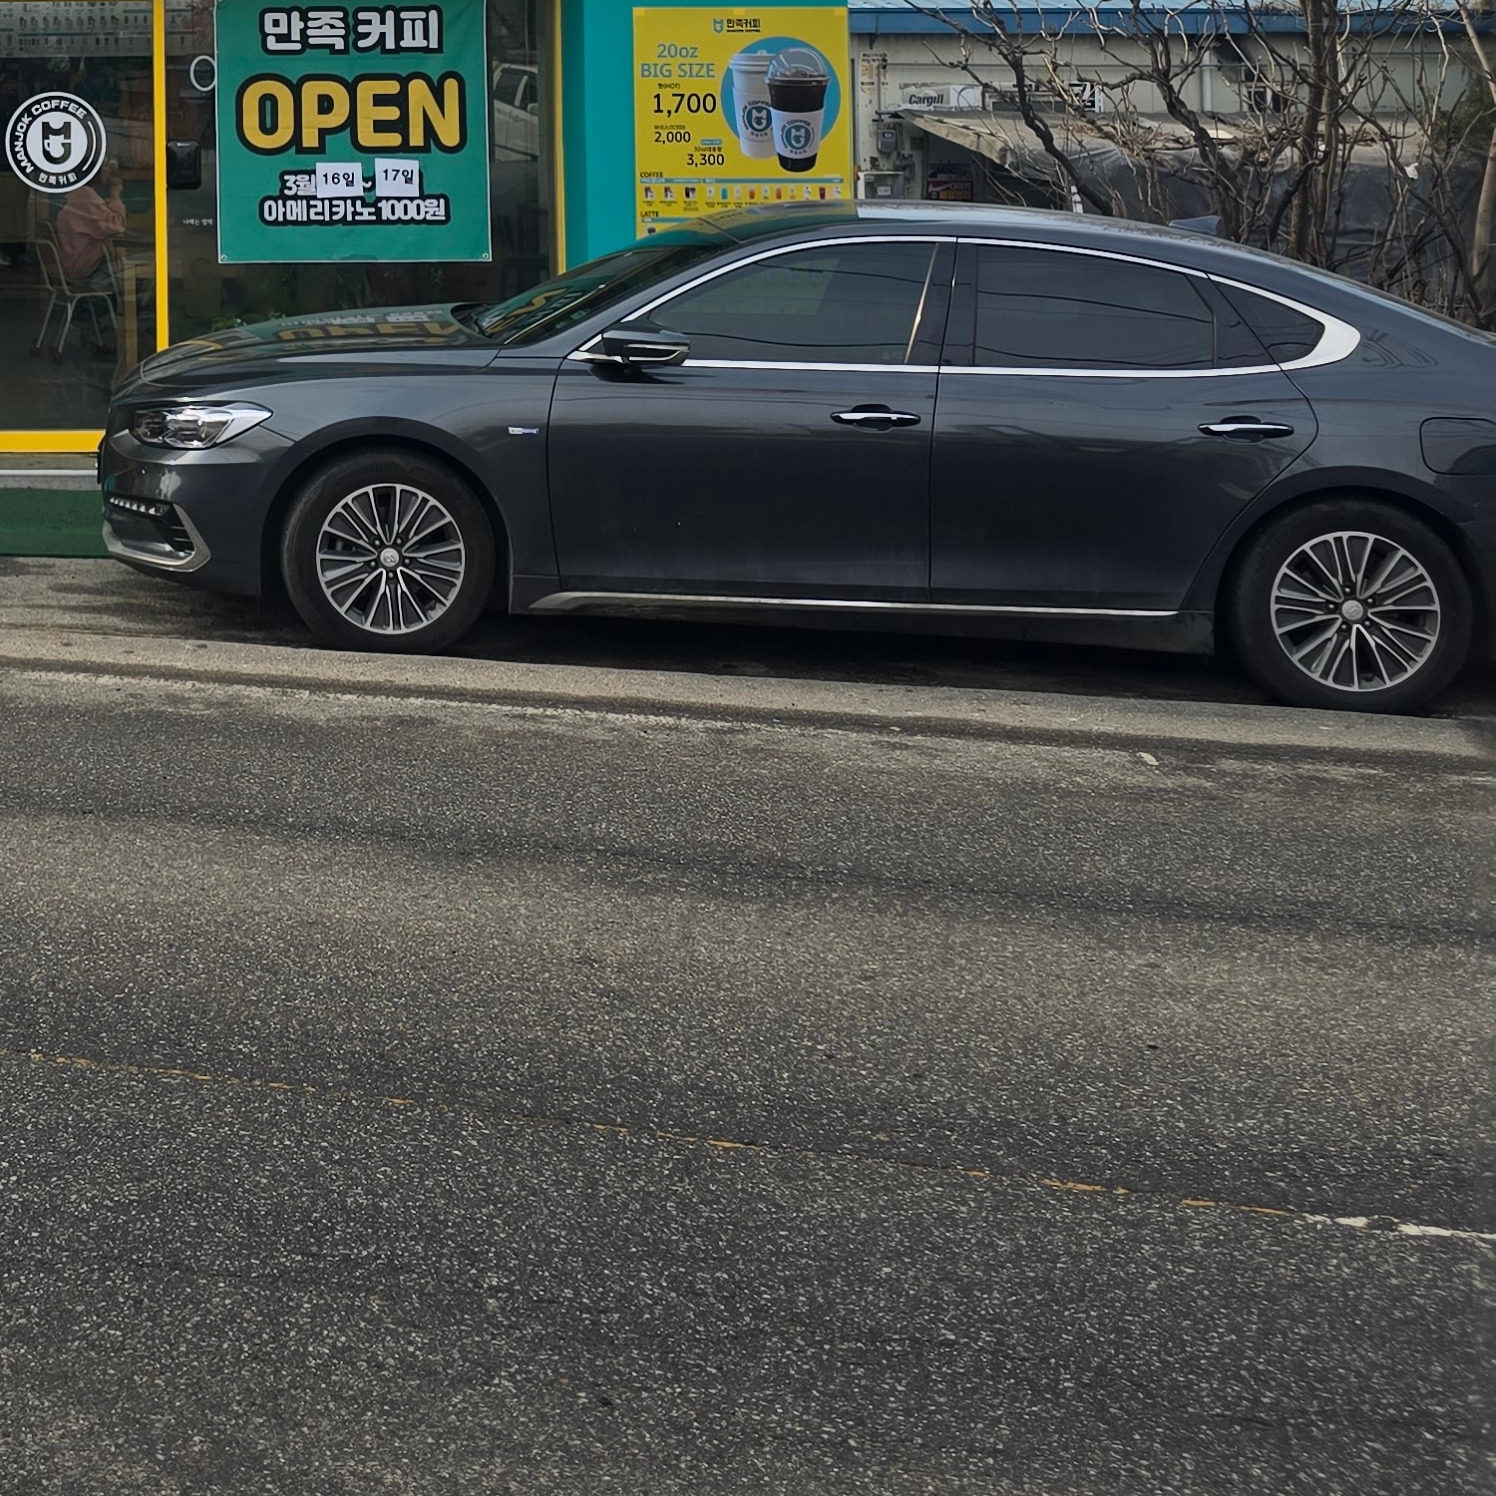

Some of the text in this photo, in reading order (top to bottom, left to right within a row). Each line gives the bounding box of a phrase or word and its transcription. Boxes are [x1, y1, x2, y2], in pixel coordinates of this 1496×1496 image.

[657, 43, 699, 58] 20oz
[640, 63, 716, 78] BIG SIZE
[653, 93, 717, 118] 1,700
[909, 94, 944, 106] Cargill
[242, 78, 461, 149] OPEN
[14, 99, 88, 174] MANJOK COFFEE
[654, 131, 691, 145] 2,000
[687, 153, 725, 168] 3,300
[322, 172, 356, 188] 16일
[382, 168, 415, 185] 17일
